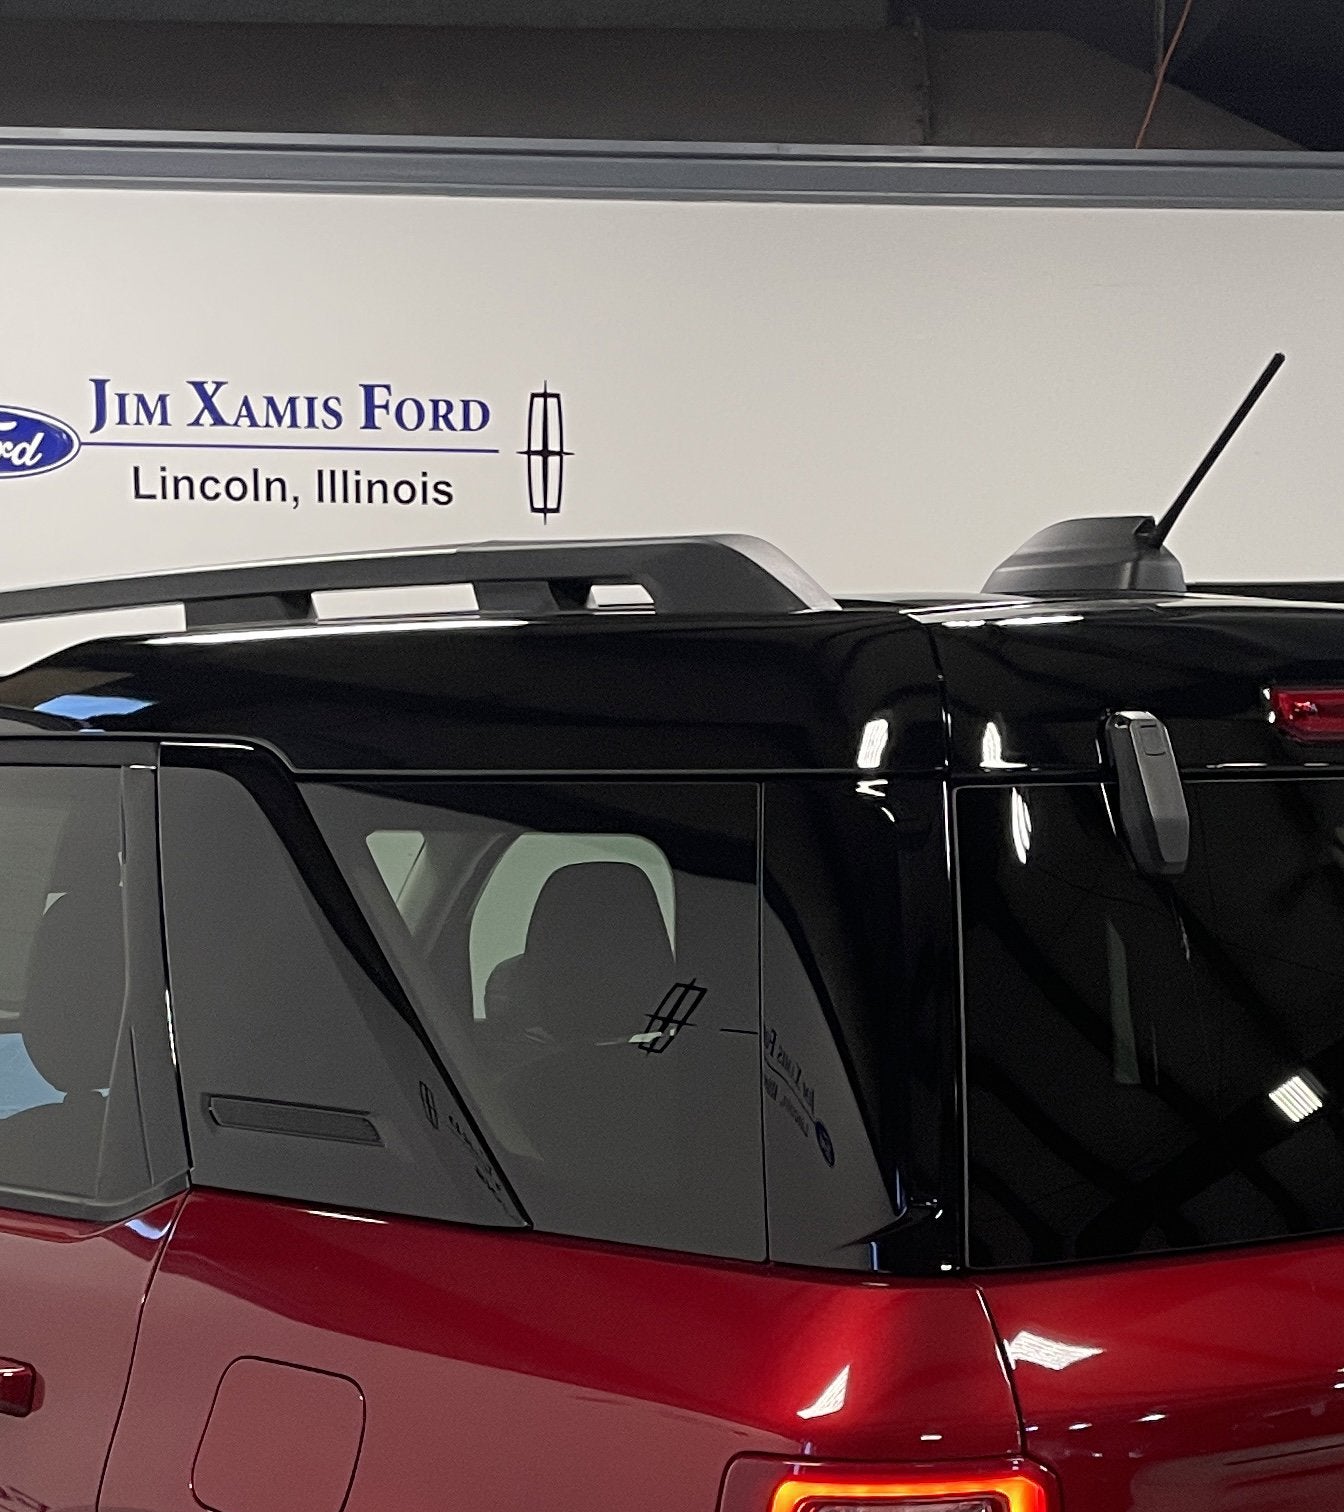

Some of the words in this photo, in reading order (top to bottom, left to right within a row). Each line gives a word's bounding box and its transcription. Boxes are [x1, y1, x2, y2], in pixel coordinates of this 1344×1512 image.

[88, 378, 172, 435] JIM
[186, 380, 344, 431] XAMIS
[358, 384, 491, 432] FORD
[132, 465, 300, 509] Lincoln,
[316, 468, 454, 506] Illinois
